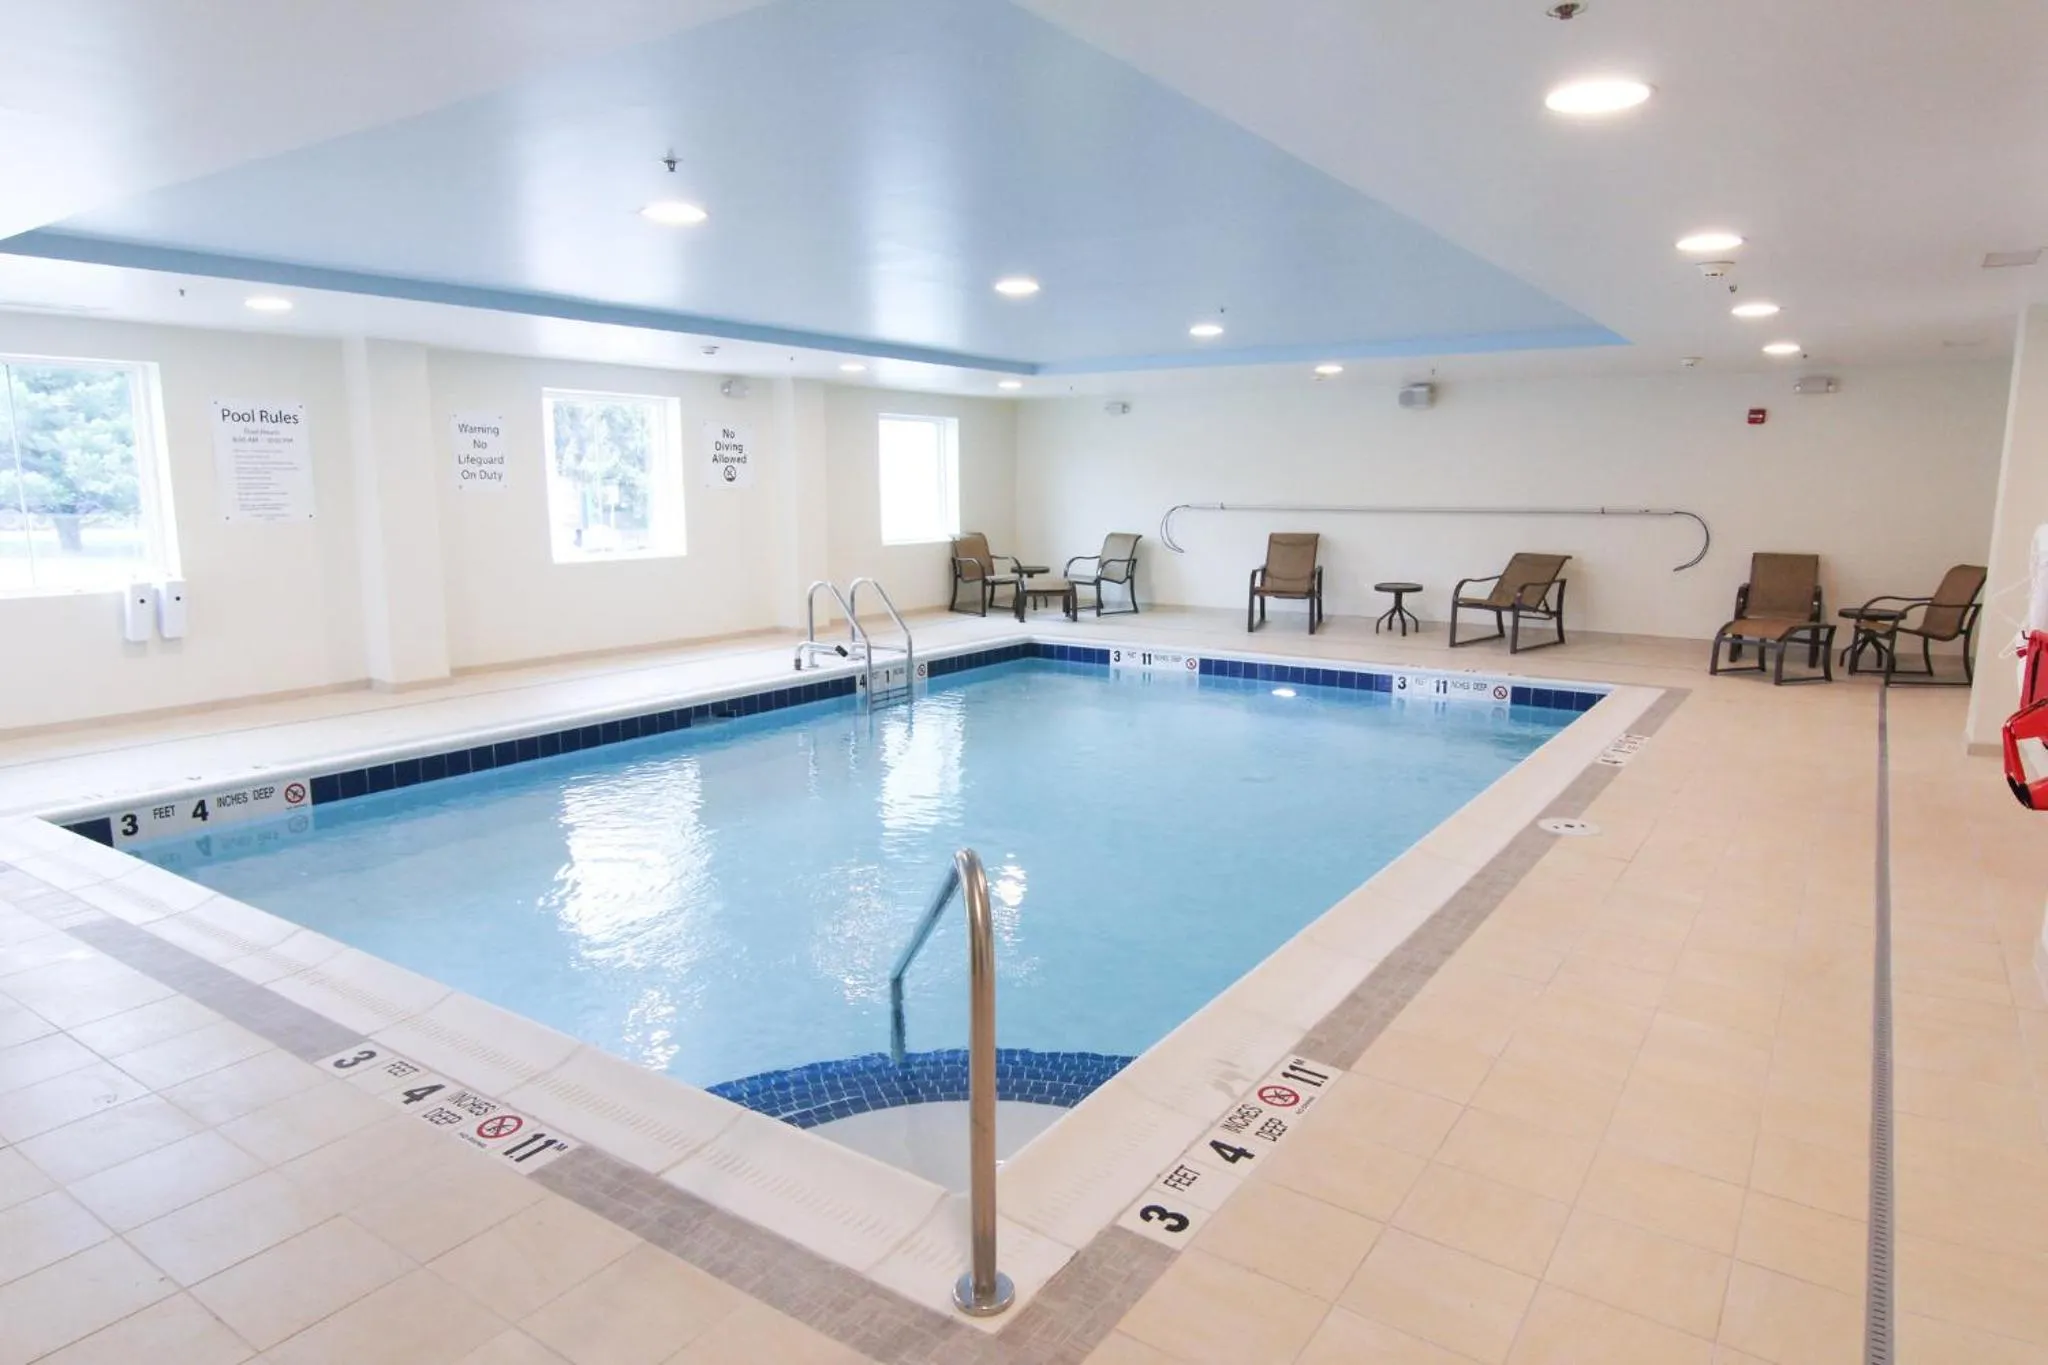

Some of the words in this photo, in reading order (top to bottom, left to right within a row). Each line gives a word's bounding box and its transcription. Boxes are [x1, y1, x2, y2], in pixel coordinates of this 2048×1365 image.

[221, 408, 255, 423] Pool
[259, 409, 300, 424] Rules
[458, 423, 500, 437] Warning
[722, 428, 736, 439] No
[473, 439, 488, 449] No
[715, 440, 744, 453] Diving
[458, 454, 505, 466] Lifeguard
[712, 453, 747, 464] Allowed
[461, 469, 477, 480] On
[479, 469, 503, 482] Duty
[1113, 650, 1121, 662] 3
[1142, 652, 1152, 665] 11
[1398, 676, 1407, 690] 3
[1436, 679, 1448, 694] 11
[121, 813, 139, 836] 3
[153, 805, 176, 820] FEET
[192, 799, 209, 821] 4
[216, 791, 249, 809] INCHES
[252, 786, 276, 801] DEEP
[333, 1050, 377, 1069] 3
[385, 1061, 420, 1077] FEET
[400, 1083, 446, 1105] 4
[447, 1090, 500, 1117] INCHES
[422, 1107, 463, 1126] DEEP
[1220, 1103, 1264, 1134] INCHES
[1255, 1117, 1288, 1142] DEEP
[1209, 1139, 1255, 1164] 4
[1163, 1164, 1201, 1192] FEET
[1139, 1204, 1190, 1233] 3
